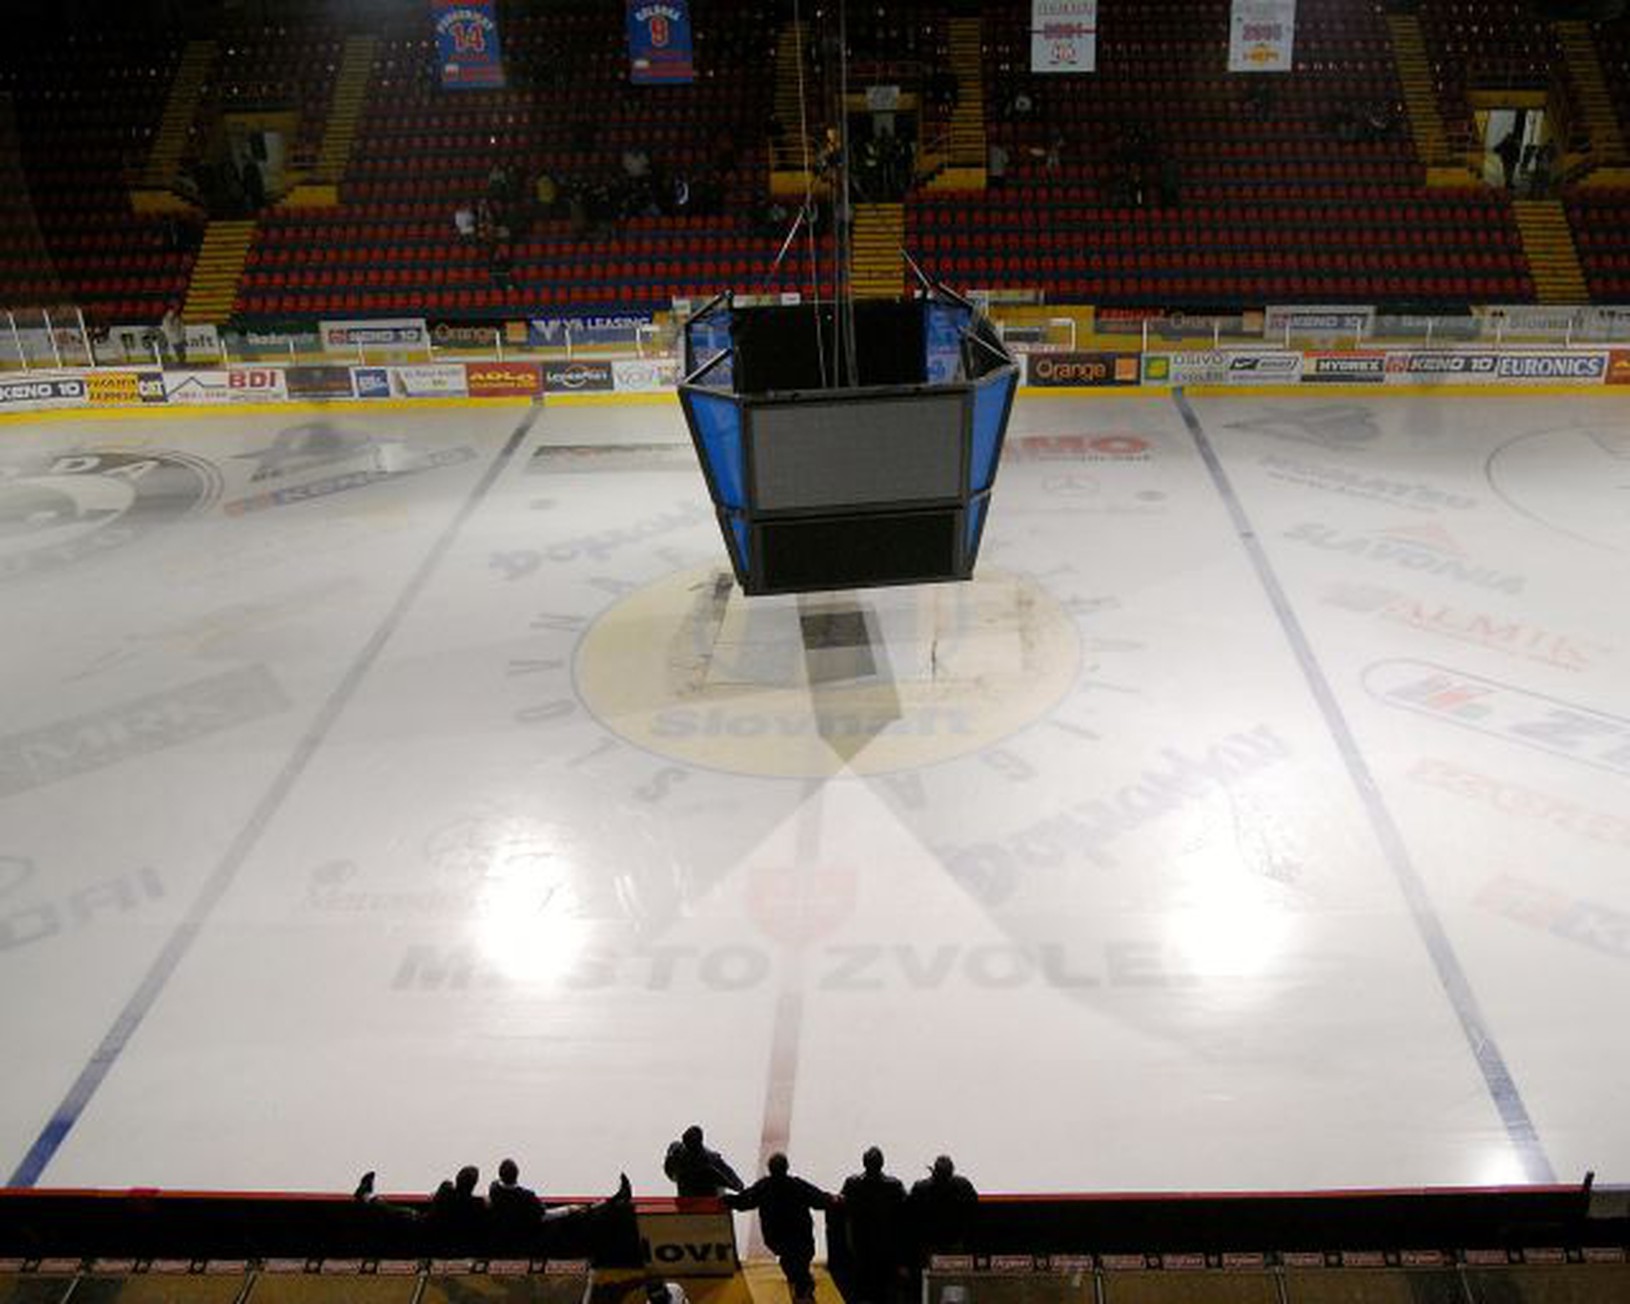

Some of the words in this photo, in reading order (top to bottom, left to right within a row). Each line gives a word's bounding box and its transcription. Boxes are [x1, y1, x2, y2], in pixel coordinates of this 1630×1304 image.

[1035, 359, 1107, 381] Orange
[1410, 357, 1463, 373] KENO
[1470, 358, 1494, 372] 10
[1499, 356, 1601, 377] EURONICS
[58, 382, 81, 397] 10
[227, 369, 277, 390] BDI
